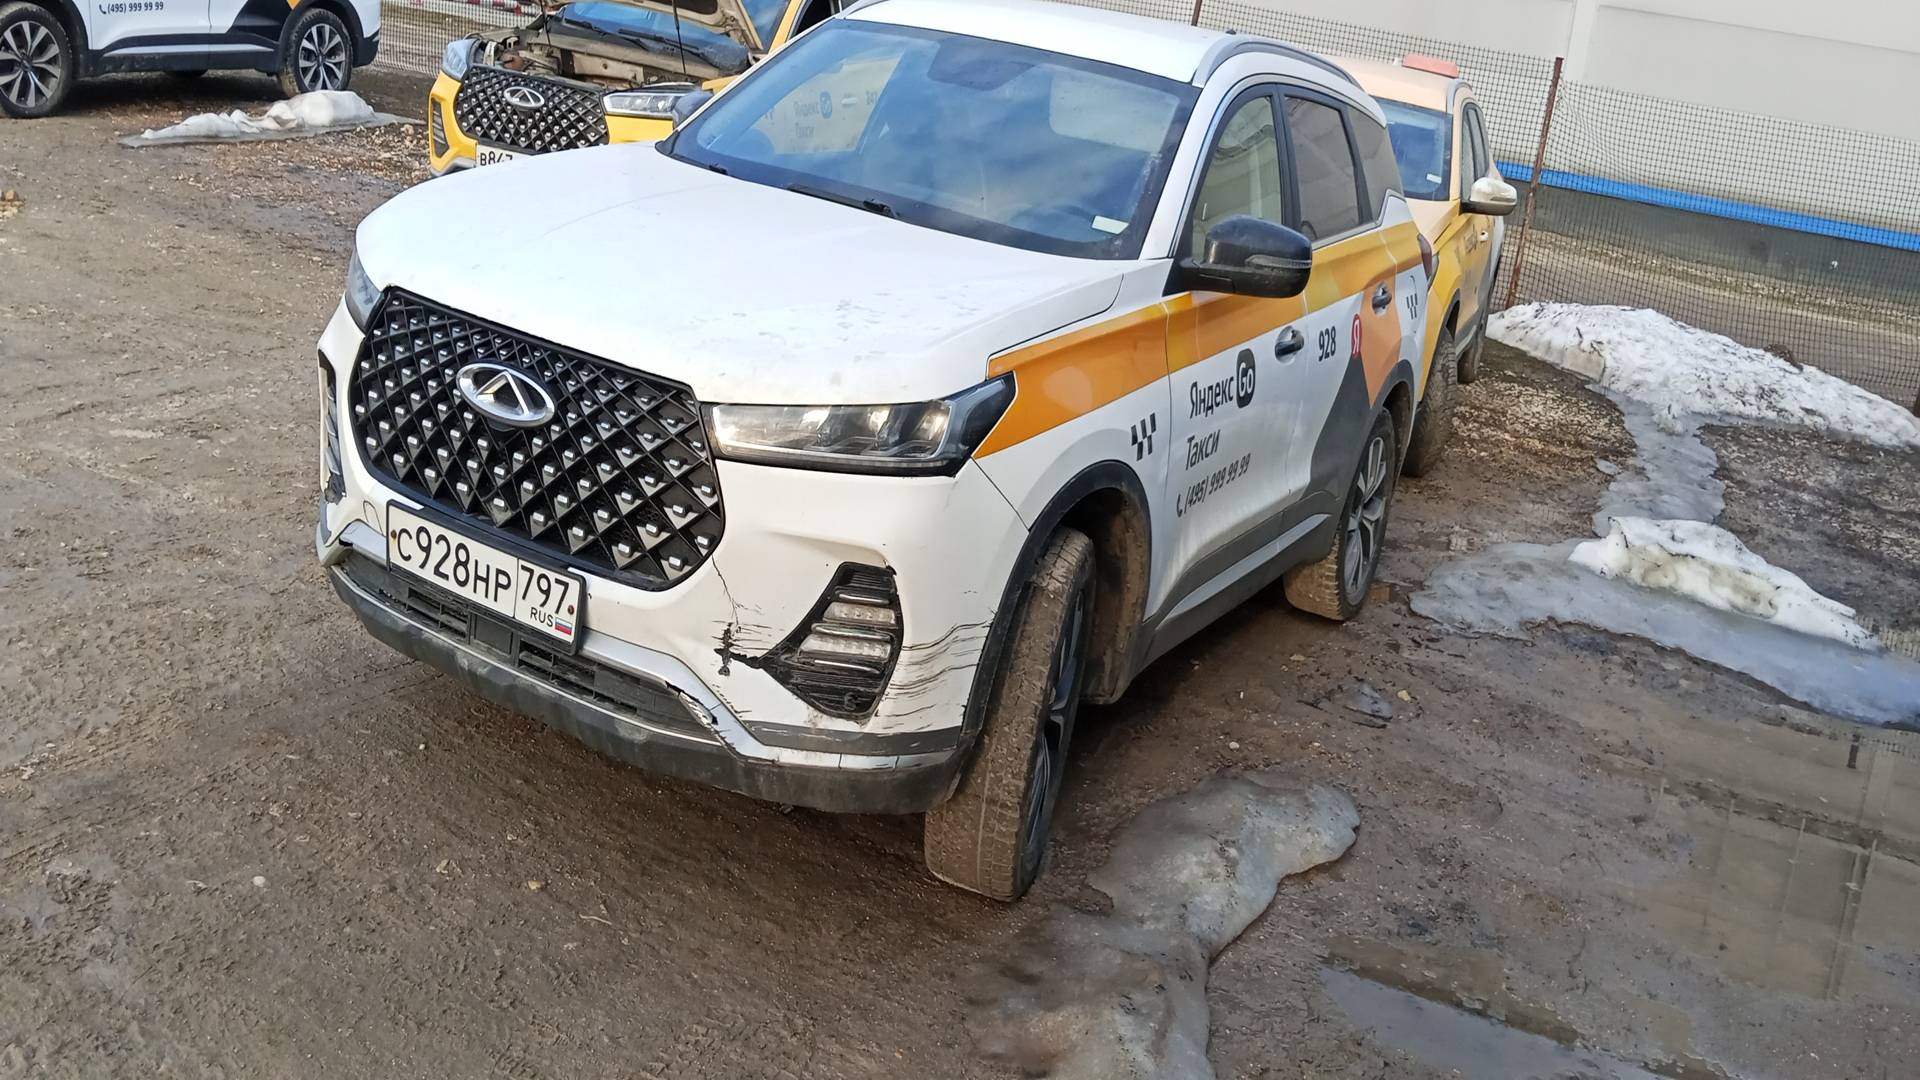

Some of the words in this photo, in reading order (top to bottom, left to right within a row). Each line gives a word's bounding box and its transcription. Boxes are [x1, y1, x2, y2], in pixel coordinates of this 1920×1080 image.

[107, 3, 127, 14] (495)
[128, 3, 142, 12] 999
[144, 2, 153, 11] 99
[154, 1, 164, 10] 99
[1318, 325, 1336, 362] 928
[1189, 375, 1234, 419] Яндекс
[1238, 361, 1254, 398] Go
[1185, 428, 1221, 471] Такси
[1184, 475, 1209, 514] (495)
[1208, 467, 1227, 496] 999
[1226, 459, 1239, 485] 99
[1238, 453, 1251, 478] 99
[519, 564, 570, 615] 797
[530, 606, 554, 628] RUS
